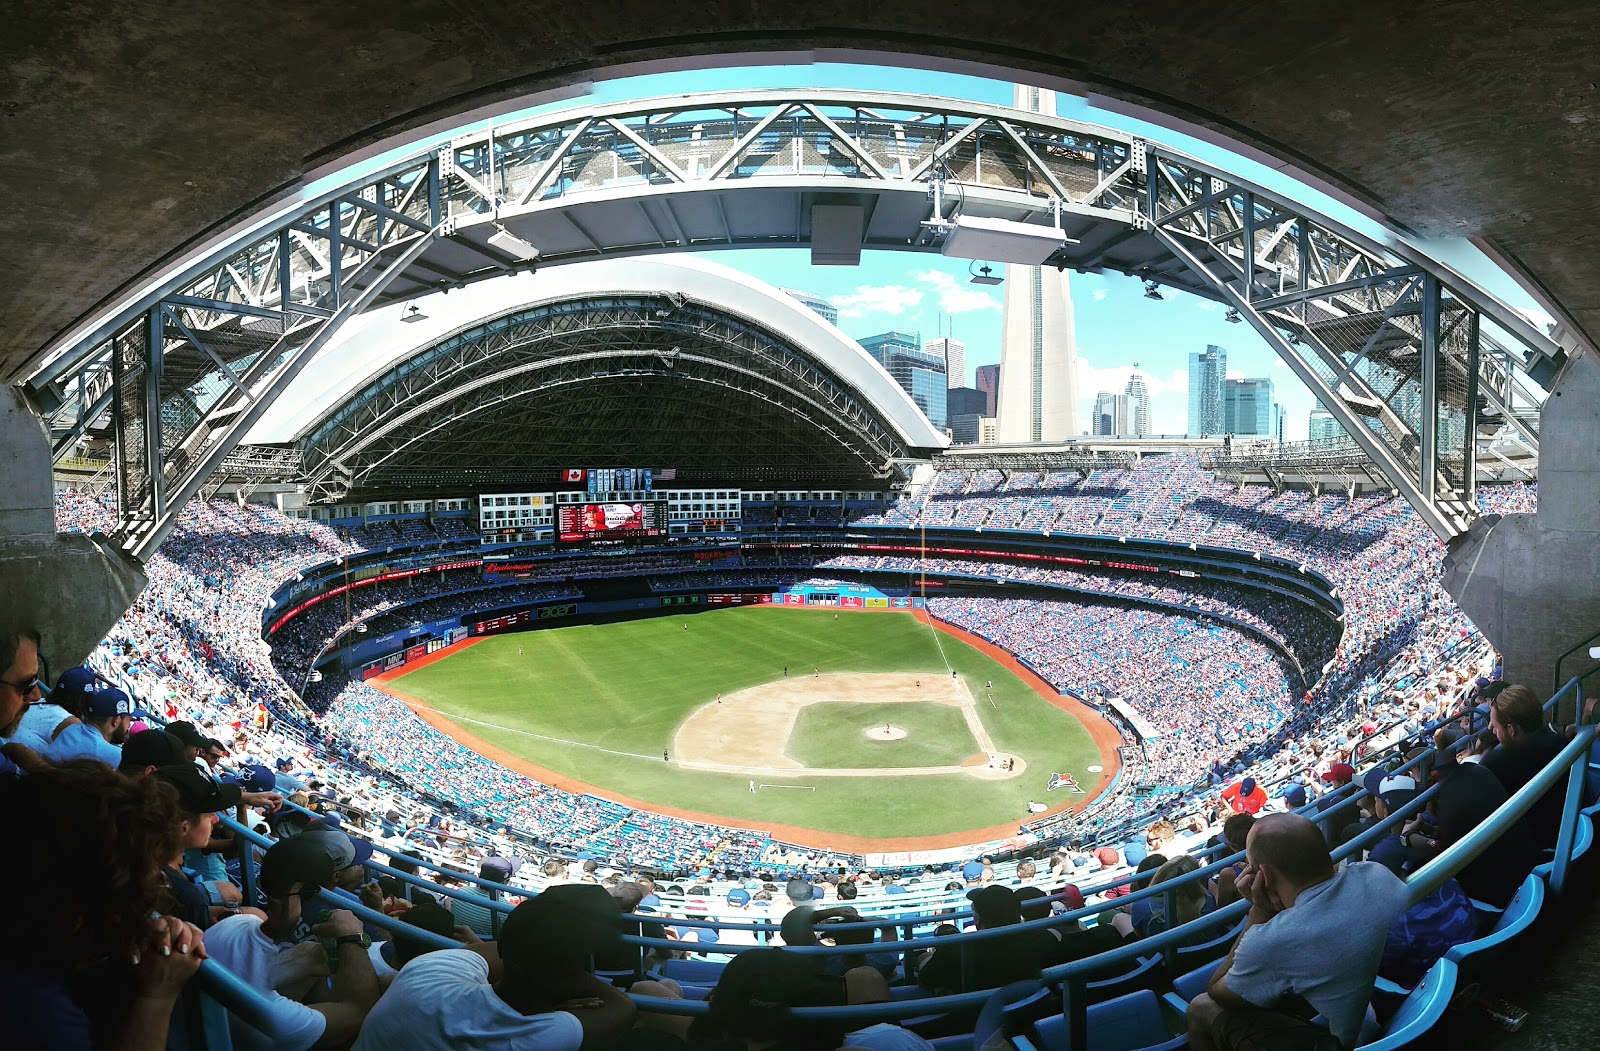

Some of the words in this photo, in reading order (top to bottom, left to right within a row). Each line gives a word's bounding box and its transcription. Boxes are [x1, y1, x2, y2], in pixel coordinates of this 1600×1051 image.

[485, 563, 533, 572] Budweiser
[541, 604, 573, 619] acer
[435, 618, 456, 626] SAMSUNG
[387, 653, 403, 666] MNP
